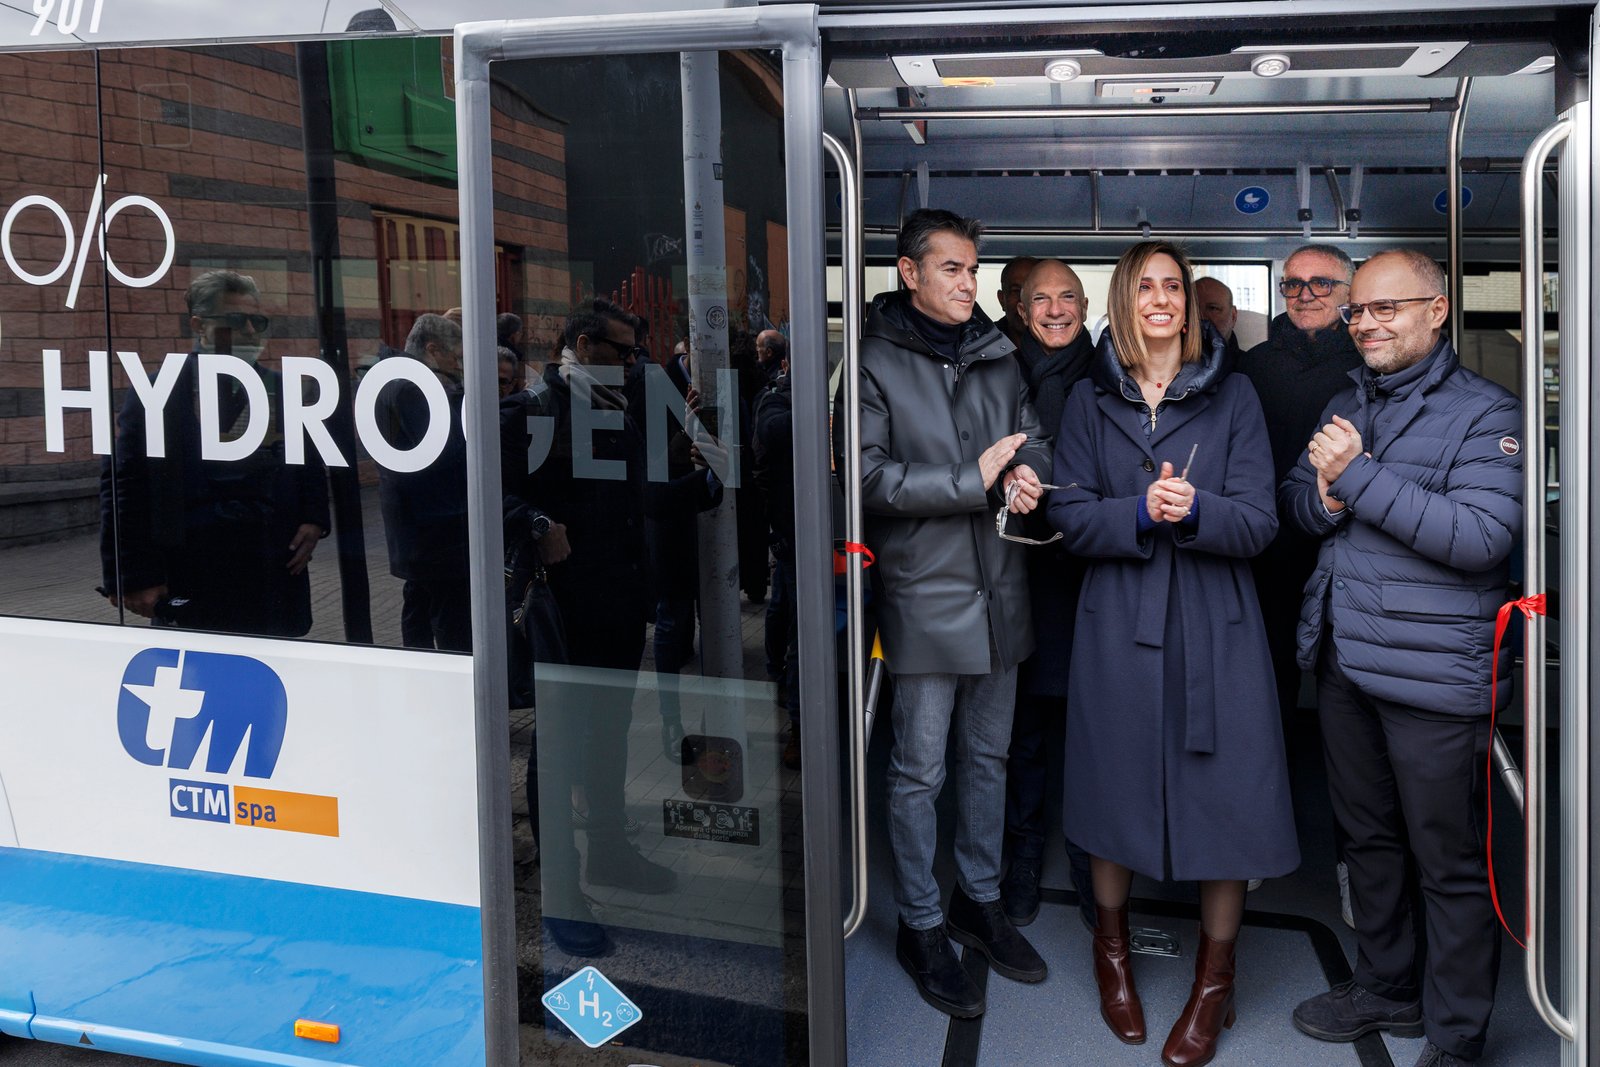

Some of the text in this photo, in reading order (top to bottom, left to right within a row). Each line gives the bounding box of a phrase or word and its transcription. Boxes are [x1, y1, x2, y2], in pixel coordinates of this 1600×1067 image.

[171, 784, 276, 825] CTM spa
[675, 823, 704, 833] Apertura
